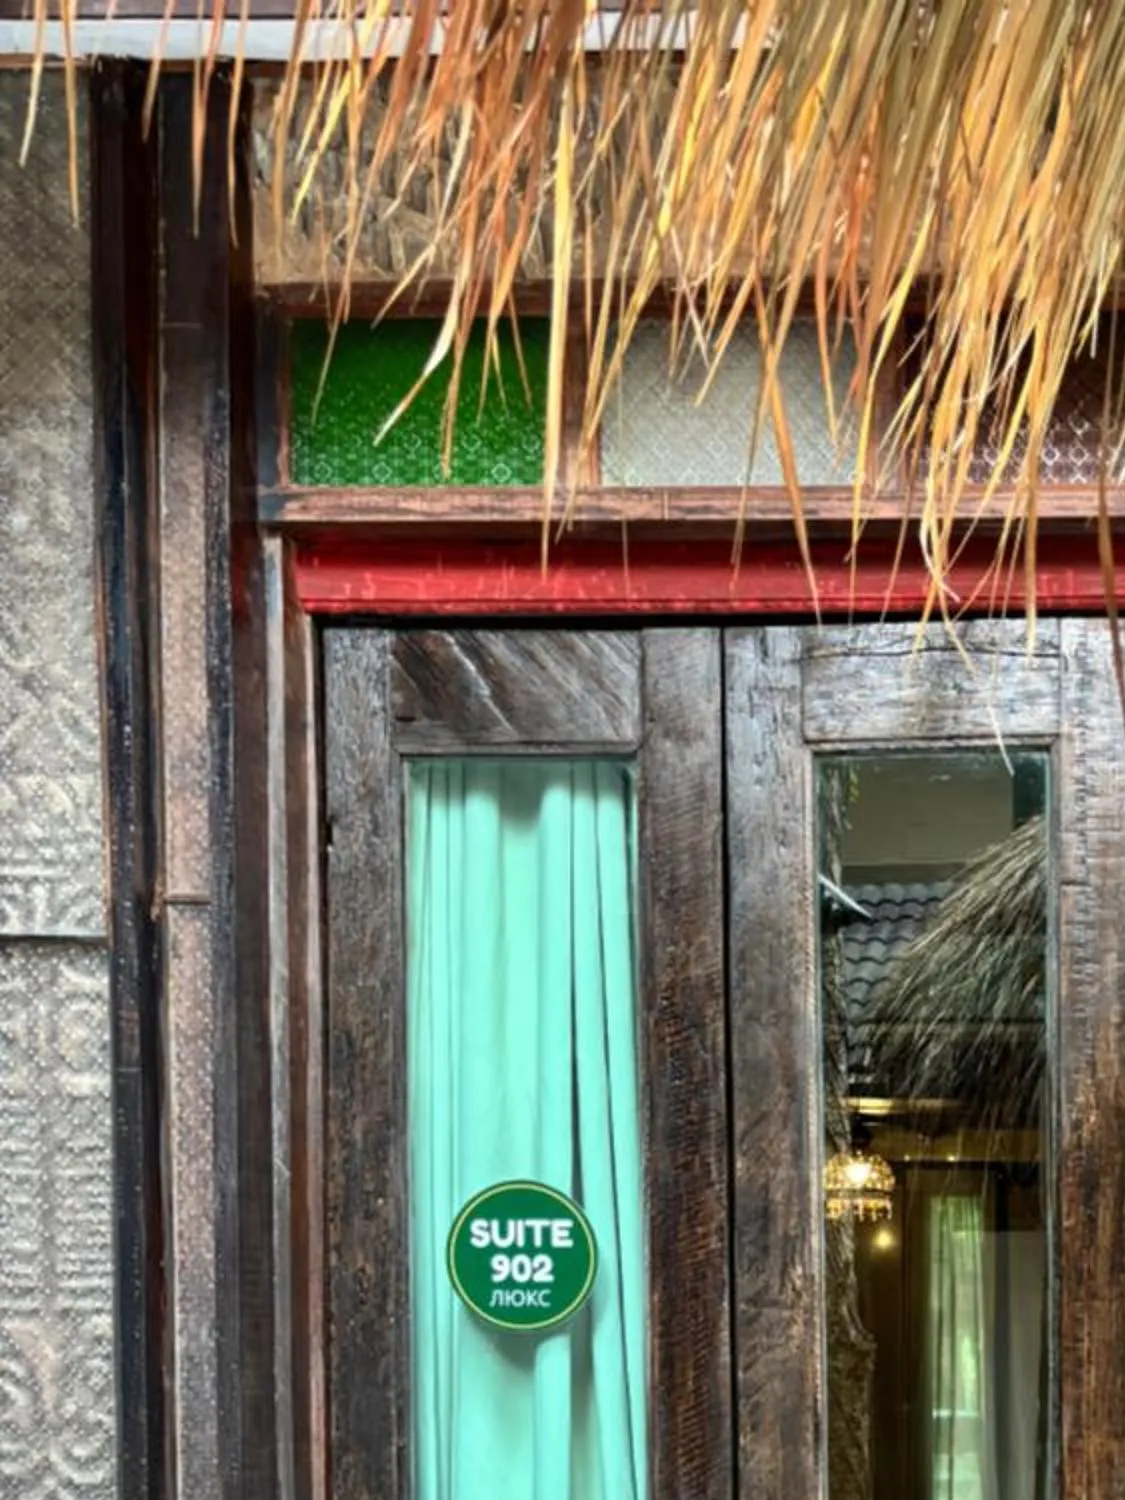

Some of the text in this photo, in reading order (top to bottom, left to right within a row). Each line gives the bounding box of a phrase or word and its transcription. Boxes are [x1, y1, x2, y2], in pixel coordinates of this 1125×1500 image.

[469, 1218, 574, 1248] SUITE
[490, 1253, 554, 1283] 902
[489, 1288, 552, 1307] ЛЮКС
